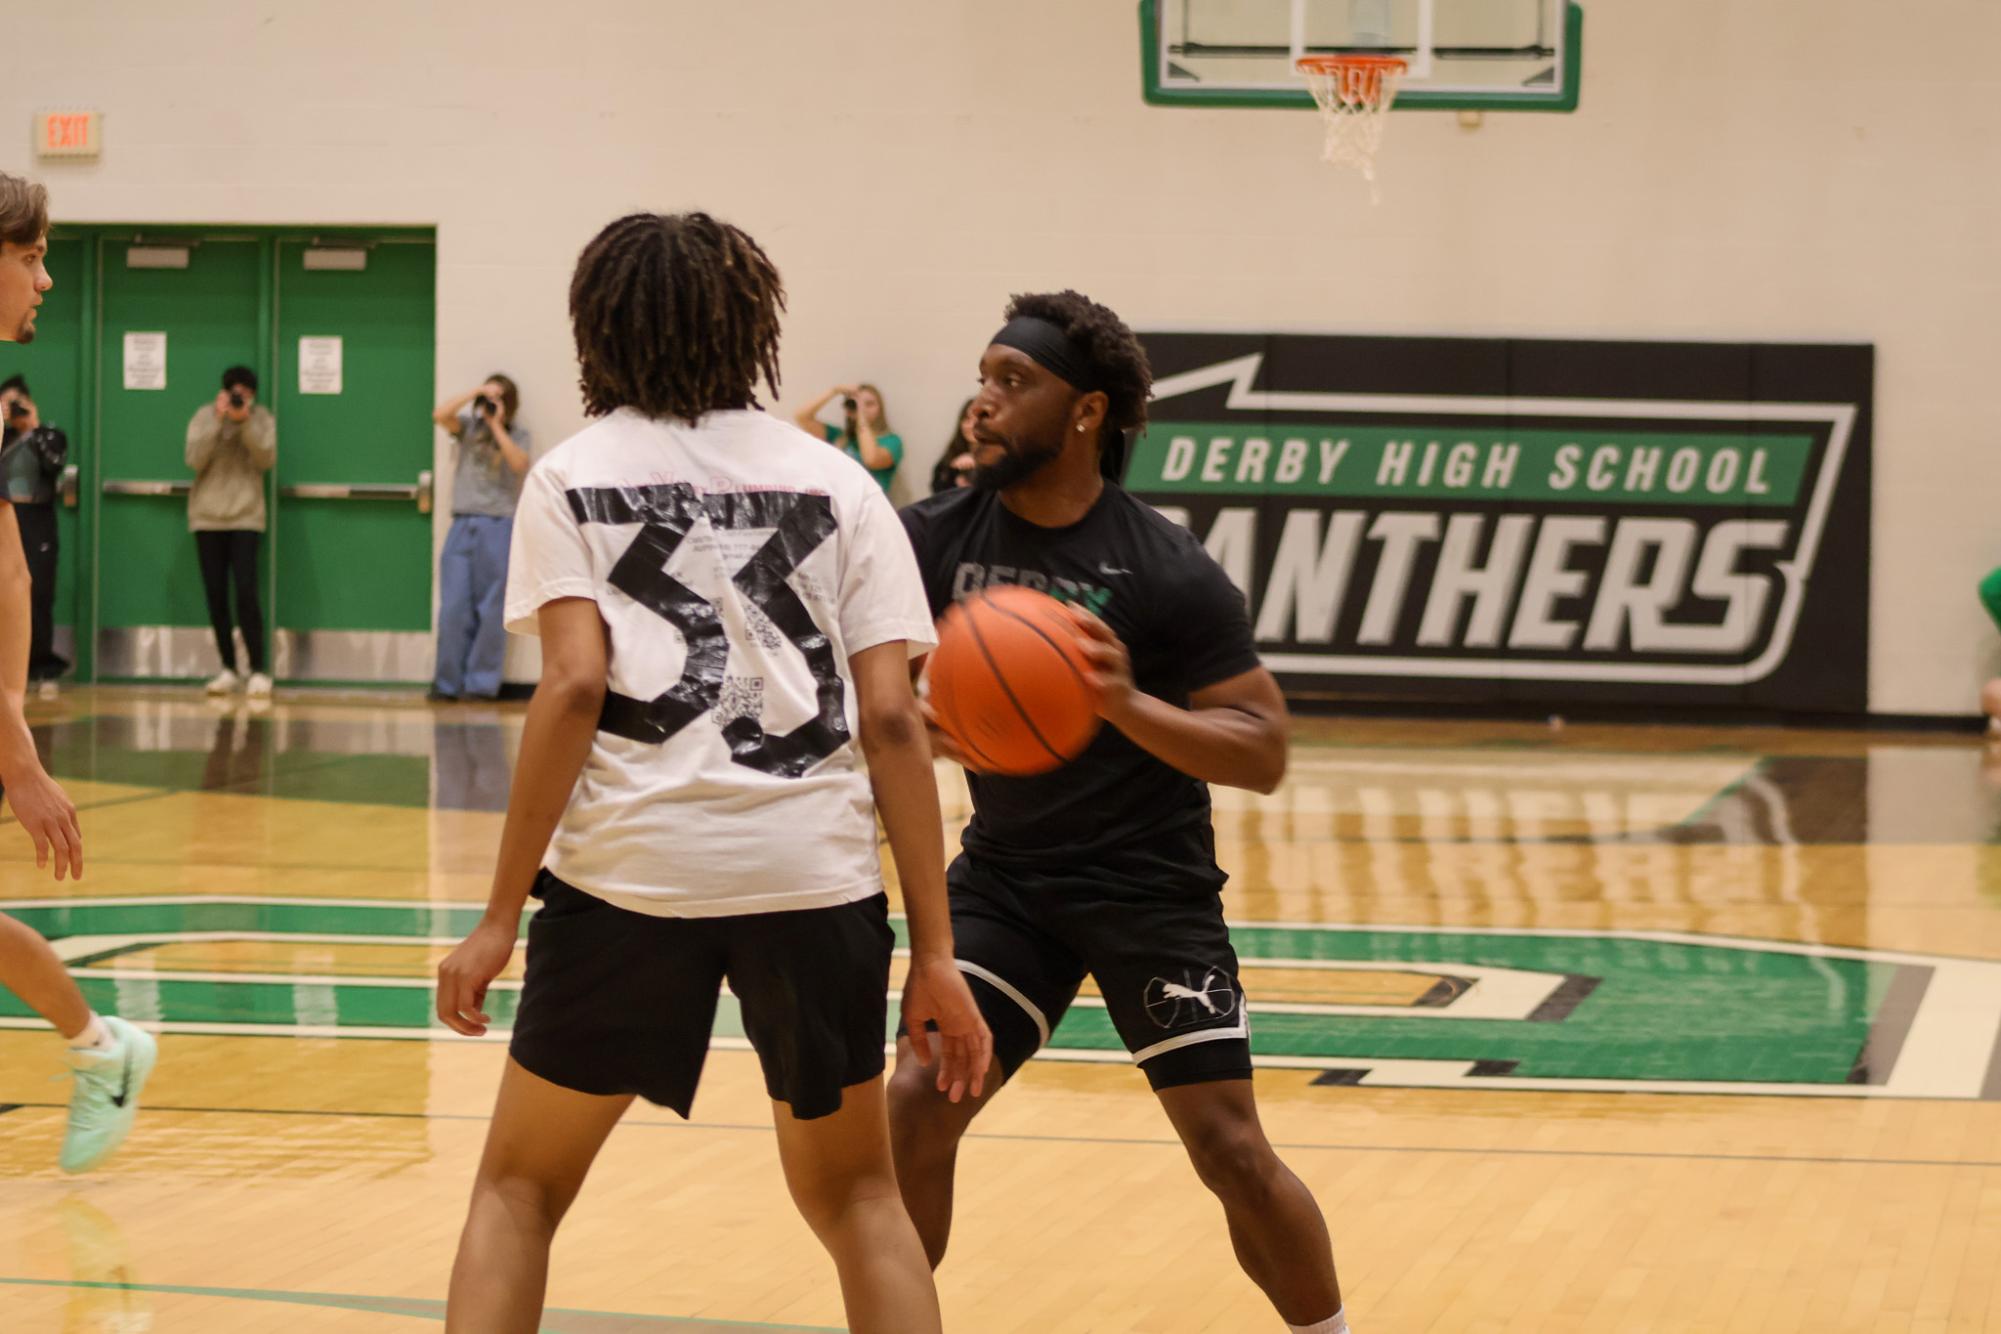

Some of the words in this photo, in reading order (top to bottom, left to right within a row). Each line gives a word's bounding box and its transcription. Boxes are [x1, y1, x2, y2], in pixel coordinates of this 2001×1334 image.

[47, 113, 89, 147] EXIT
[1161, 435, 1350, 484] DERBY
[1376, 442, 1521, 488] HIGH
[1548, 444, 1772, 494] SCHOOL
[1151, 506, 1791, 651] ANTHERS
[565, 482, 852, 780] 33
